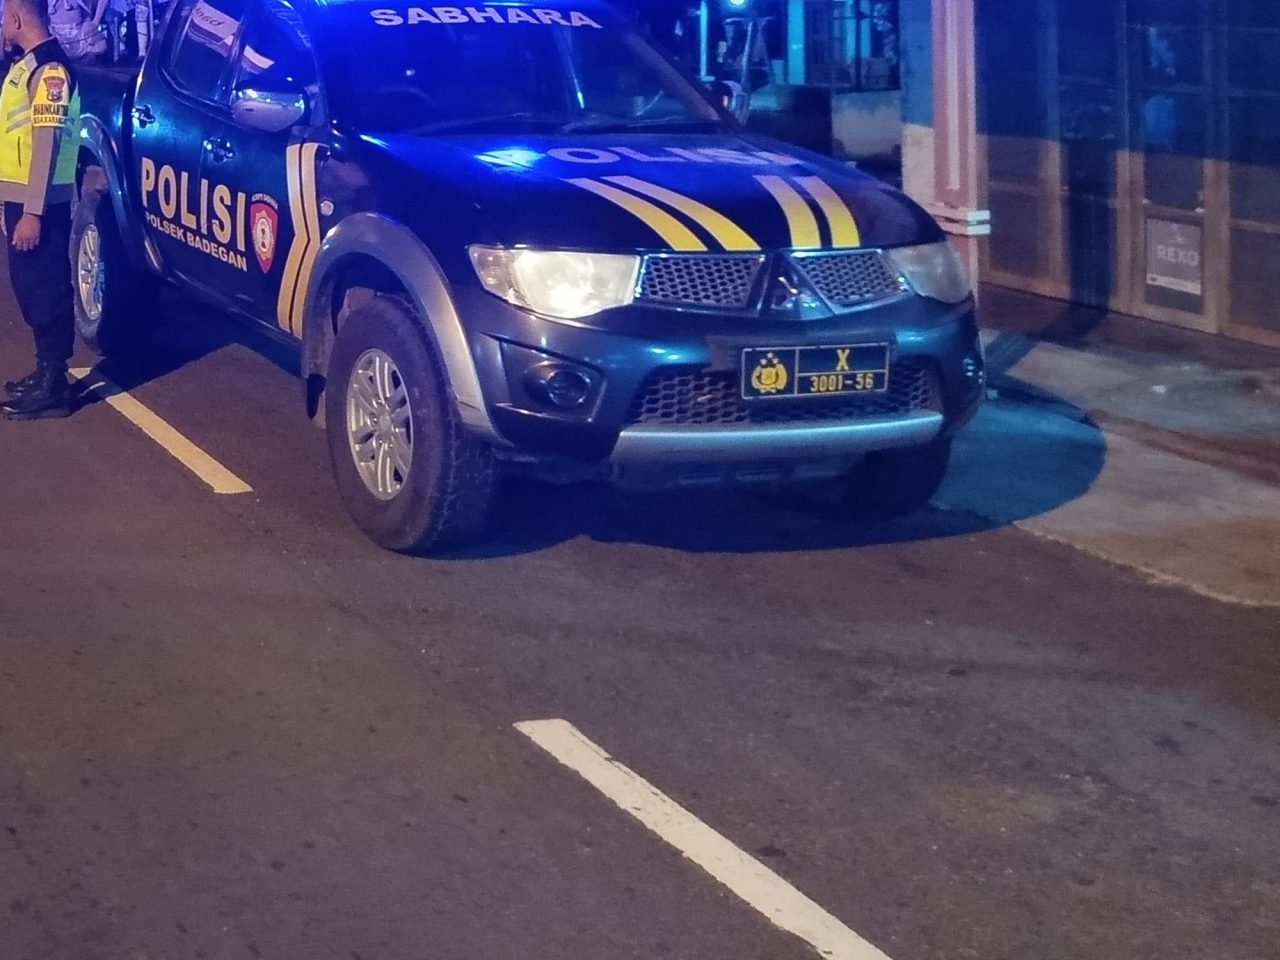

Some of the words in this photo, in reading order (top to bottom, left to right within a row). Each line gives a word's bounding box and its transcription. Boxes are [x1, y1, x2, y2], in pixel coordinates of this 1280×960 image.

[370, 6, 603, 29] SABHARA
[141, 156, 247, 253] POLISI
[145, 210, 186, 242] POLSEK
[187, 231, 248, 272] BADEGAN
[836, 348, 851, 371] X
[809, 372, 875, 393] 3001-56
